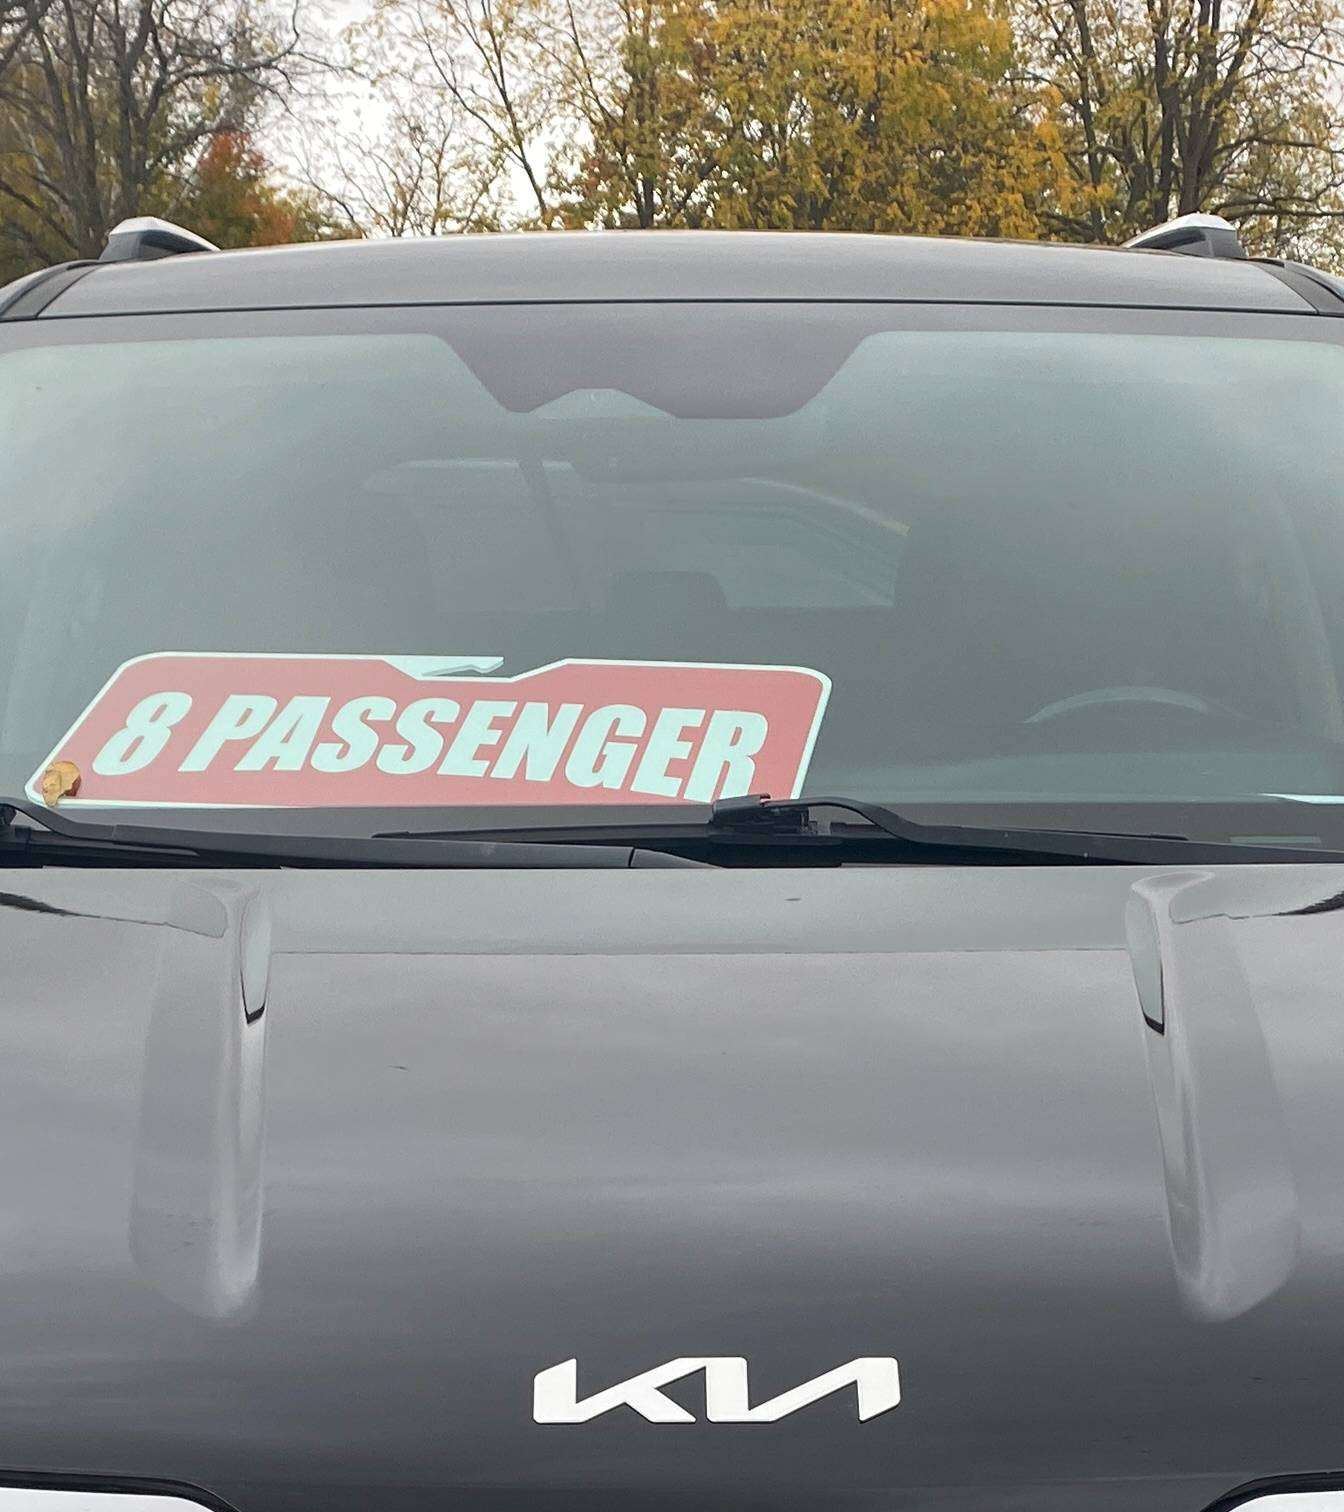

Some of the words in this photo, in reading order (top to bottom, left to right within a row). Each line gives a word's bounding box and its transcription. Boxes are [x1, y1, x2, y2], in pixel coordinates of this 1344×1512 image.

[92, 691, 193, 776] 8
[177, 694, 769, 804] PASSENGER
[533, 1356, 901, 1423] KIA
